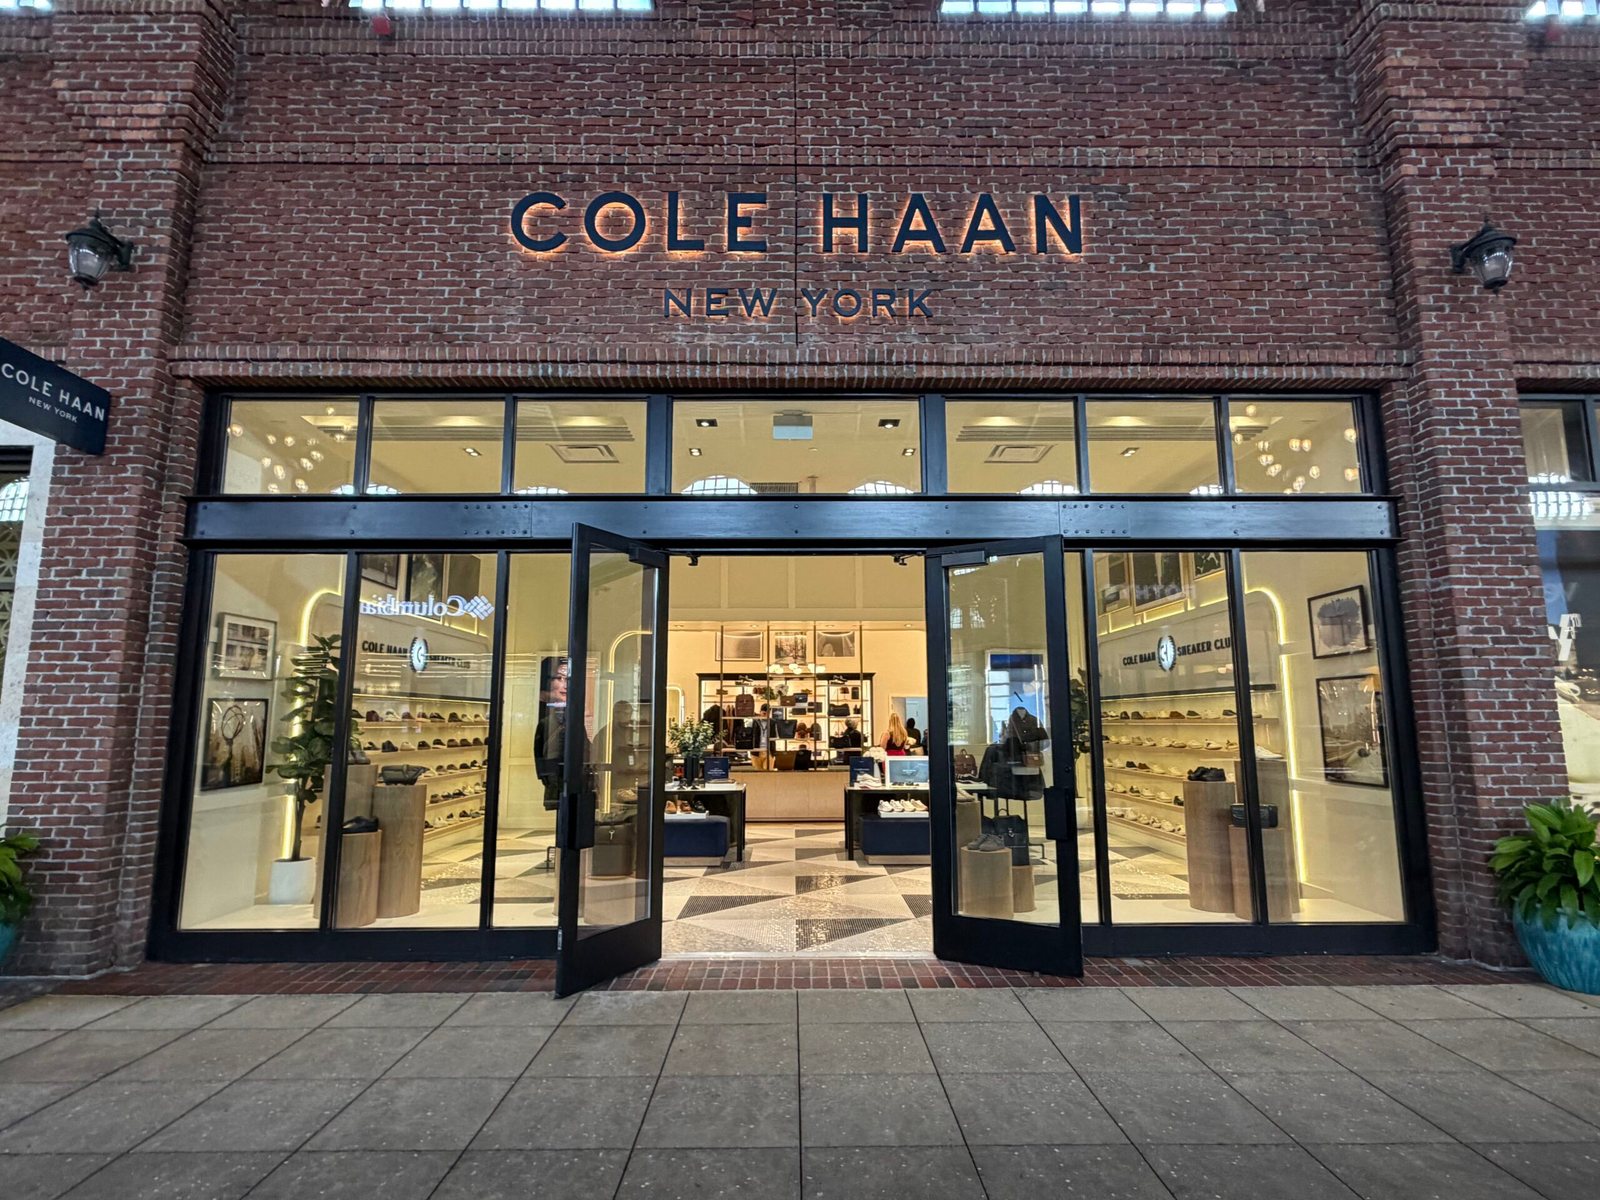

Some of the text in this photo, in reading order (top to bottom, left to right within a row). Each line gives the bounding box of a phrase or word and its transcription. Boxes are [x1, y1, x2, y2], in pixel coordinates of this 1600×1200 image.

[511, 192, 1082, 254] COLE HAAN
[664, 287, 933, 318] NEW YORK
[1, 363, 105, 421] COLE HAAN
[28, 396, 78, 423] NEW YORK
[362, 640, 384, 653] COLE
[1122, 656, 1139, 666] COLE
[1177, 641, 1212, 657] SNEAKER
[1214, 637, 1232, 650] CLU
